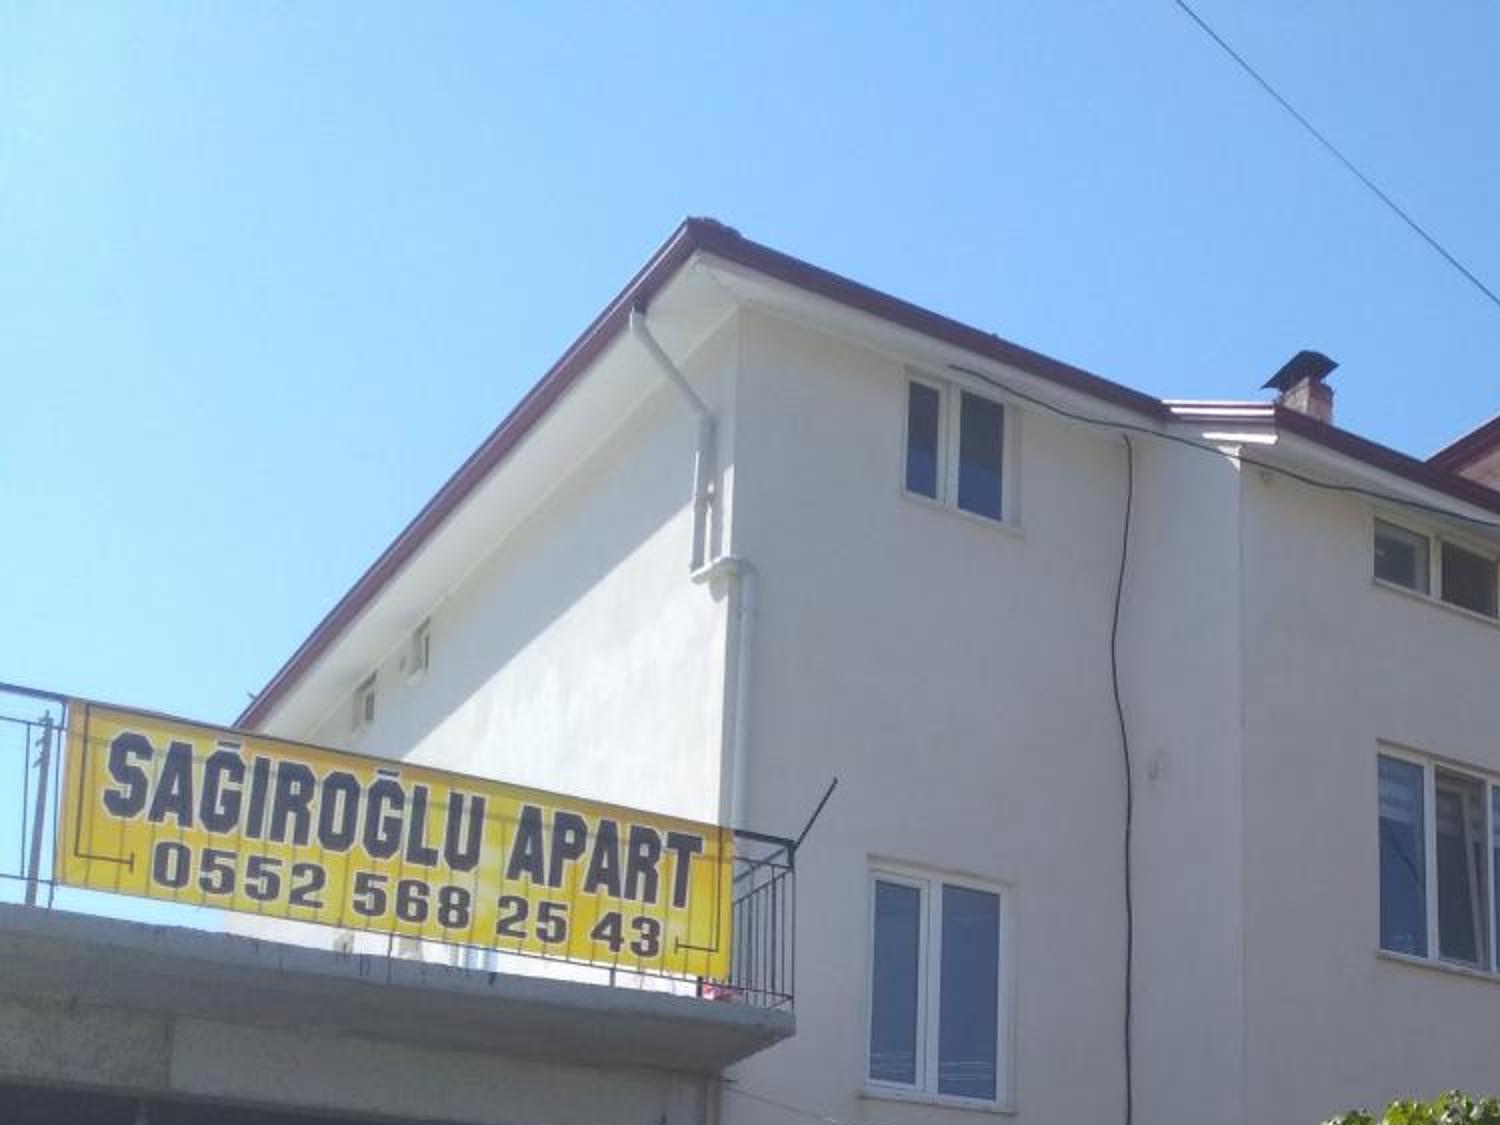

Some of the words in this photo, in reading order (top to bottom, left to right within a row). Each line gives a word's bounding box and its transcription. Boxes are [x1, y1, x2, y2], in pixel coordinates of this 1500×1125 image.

[103, 731, 485, 872] SAĞIROĞLU
[507, 805, 702, 908] APART
[153, 841, 325, 909] 0552
[353, 874, 470, 929] 568
[496, 895, 568, 943] 25
[591, 911, 661, 958] 43
